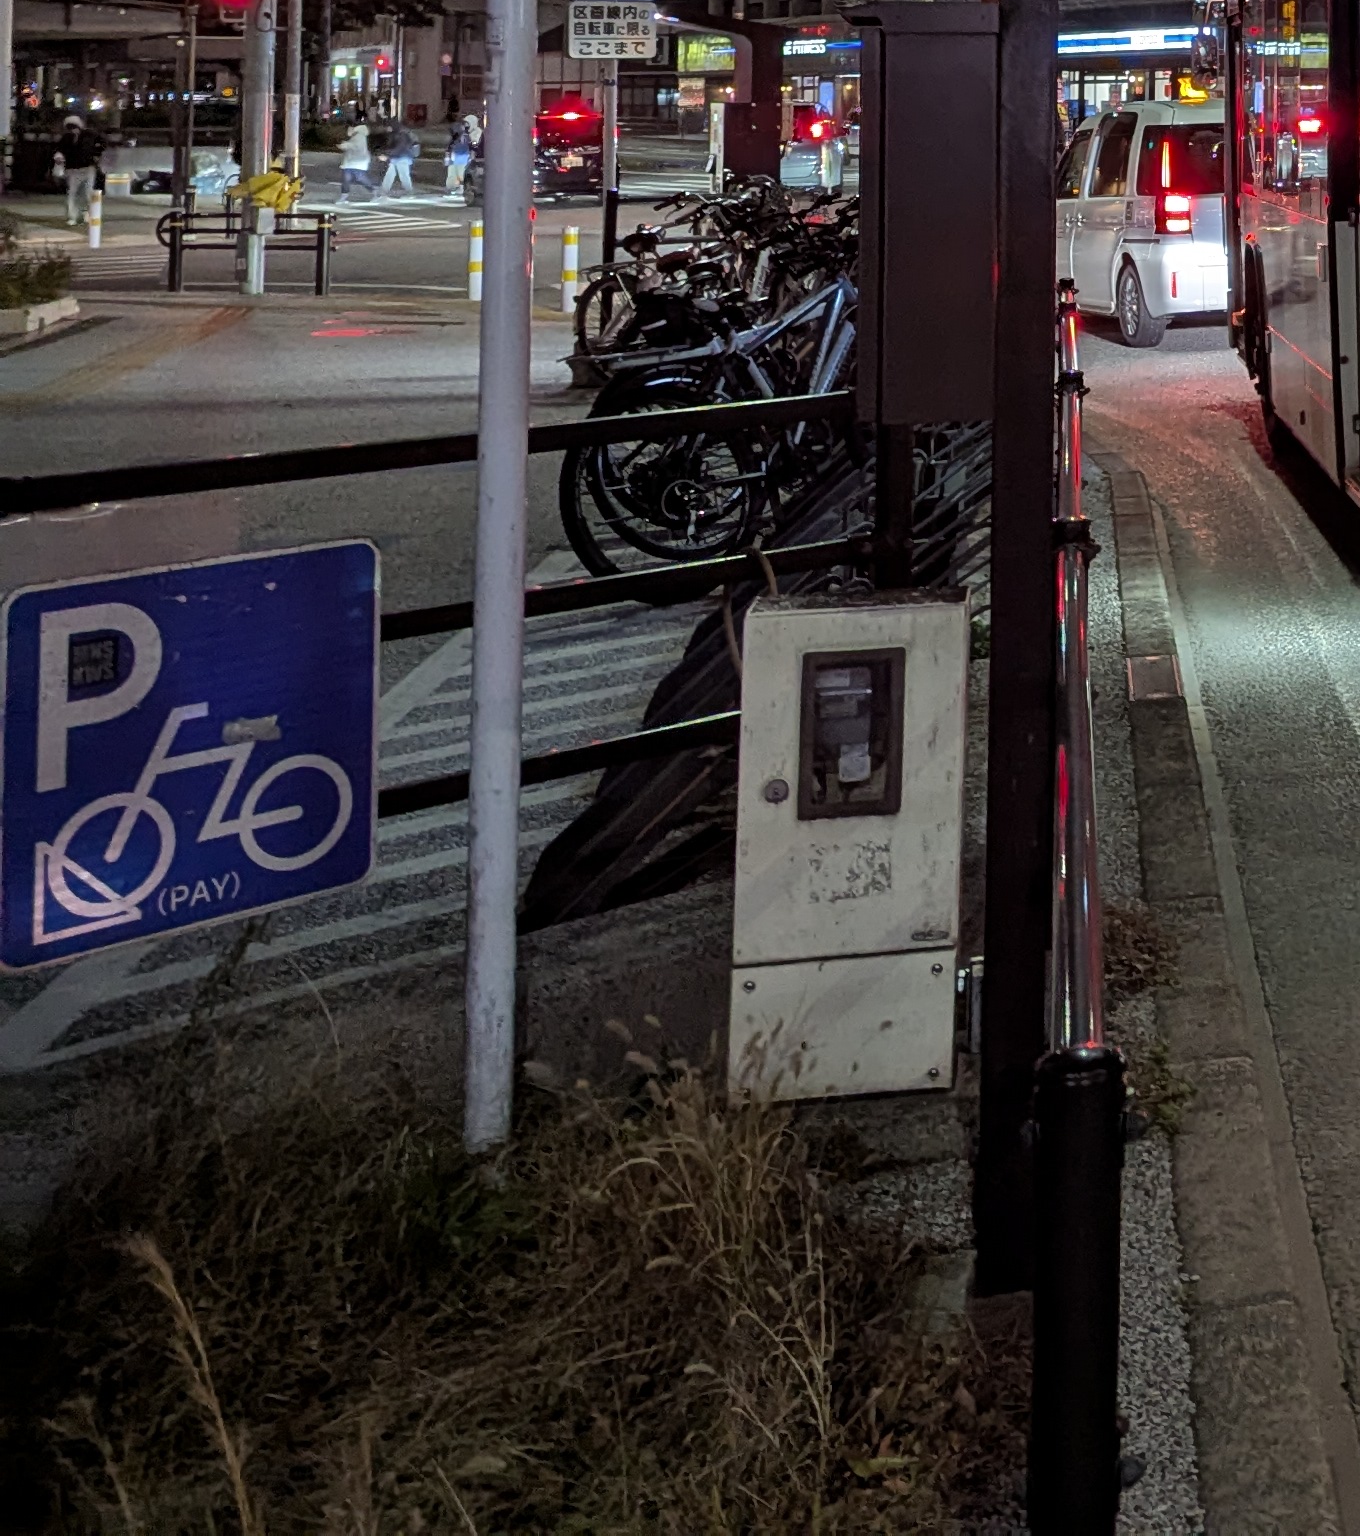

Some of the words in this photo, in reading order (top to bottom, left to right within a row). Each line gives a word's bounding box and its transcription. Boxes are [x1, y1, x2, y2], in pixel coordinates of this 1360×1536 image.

[573, 5, 650, 20] 区画線内の
[573, 21, 651, 37] 自転車に限る
[578, 41, 646, 56] ここまで
[36, 602, 163, 793] P
[157, 872, 241, 916] (PAY)
